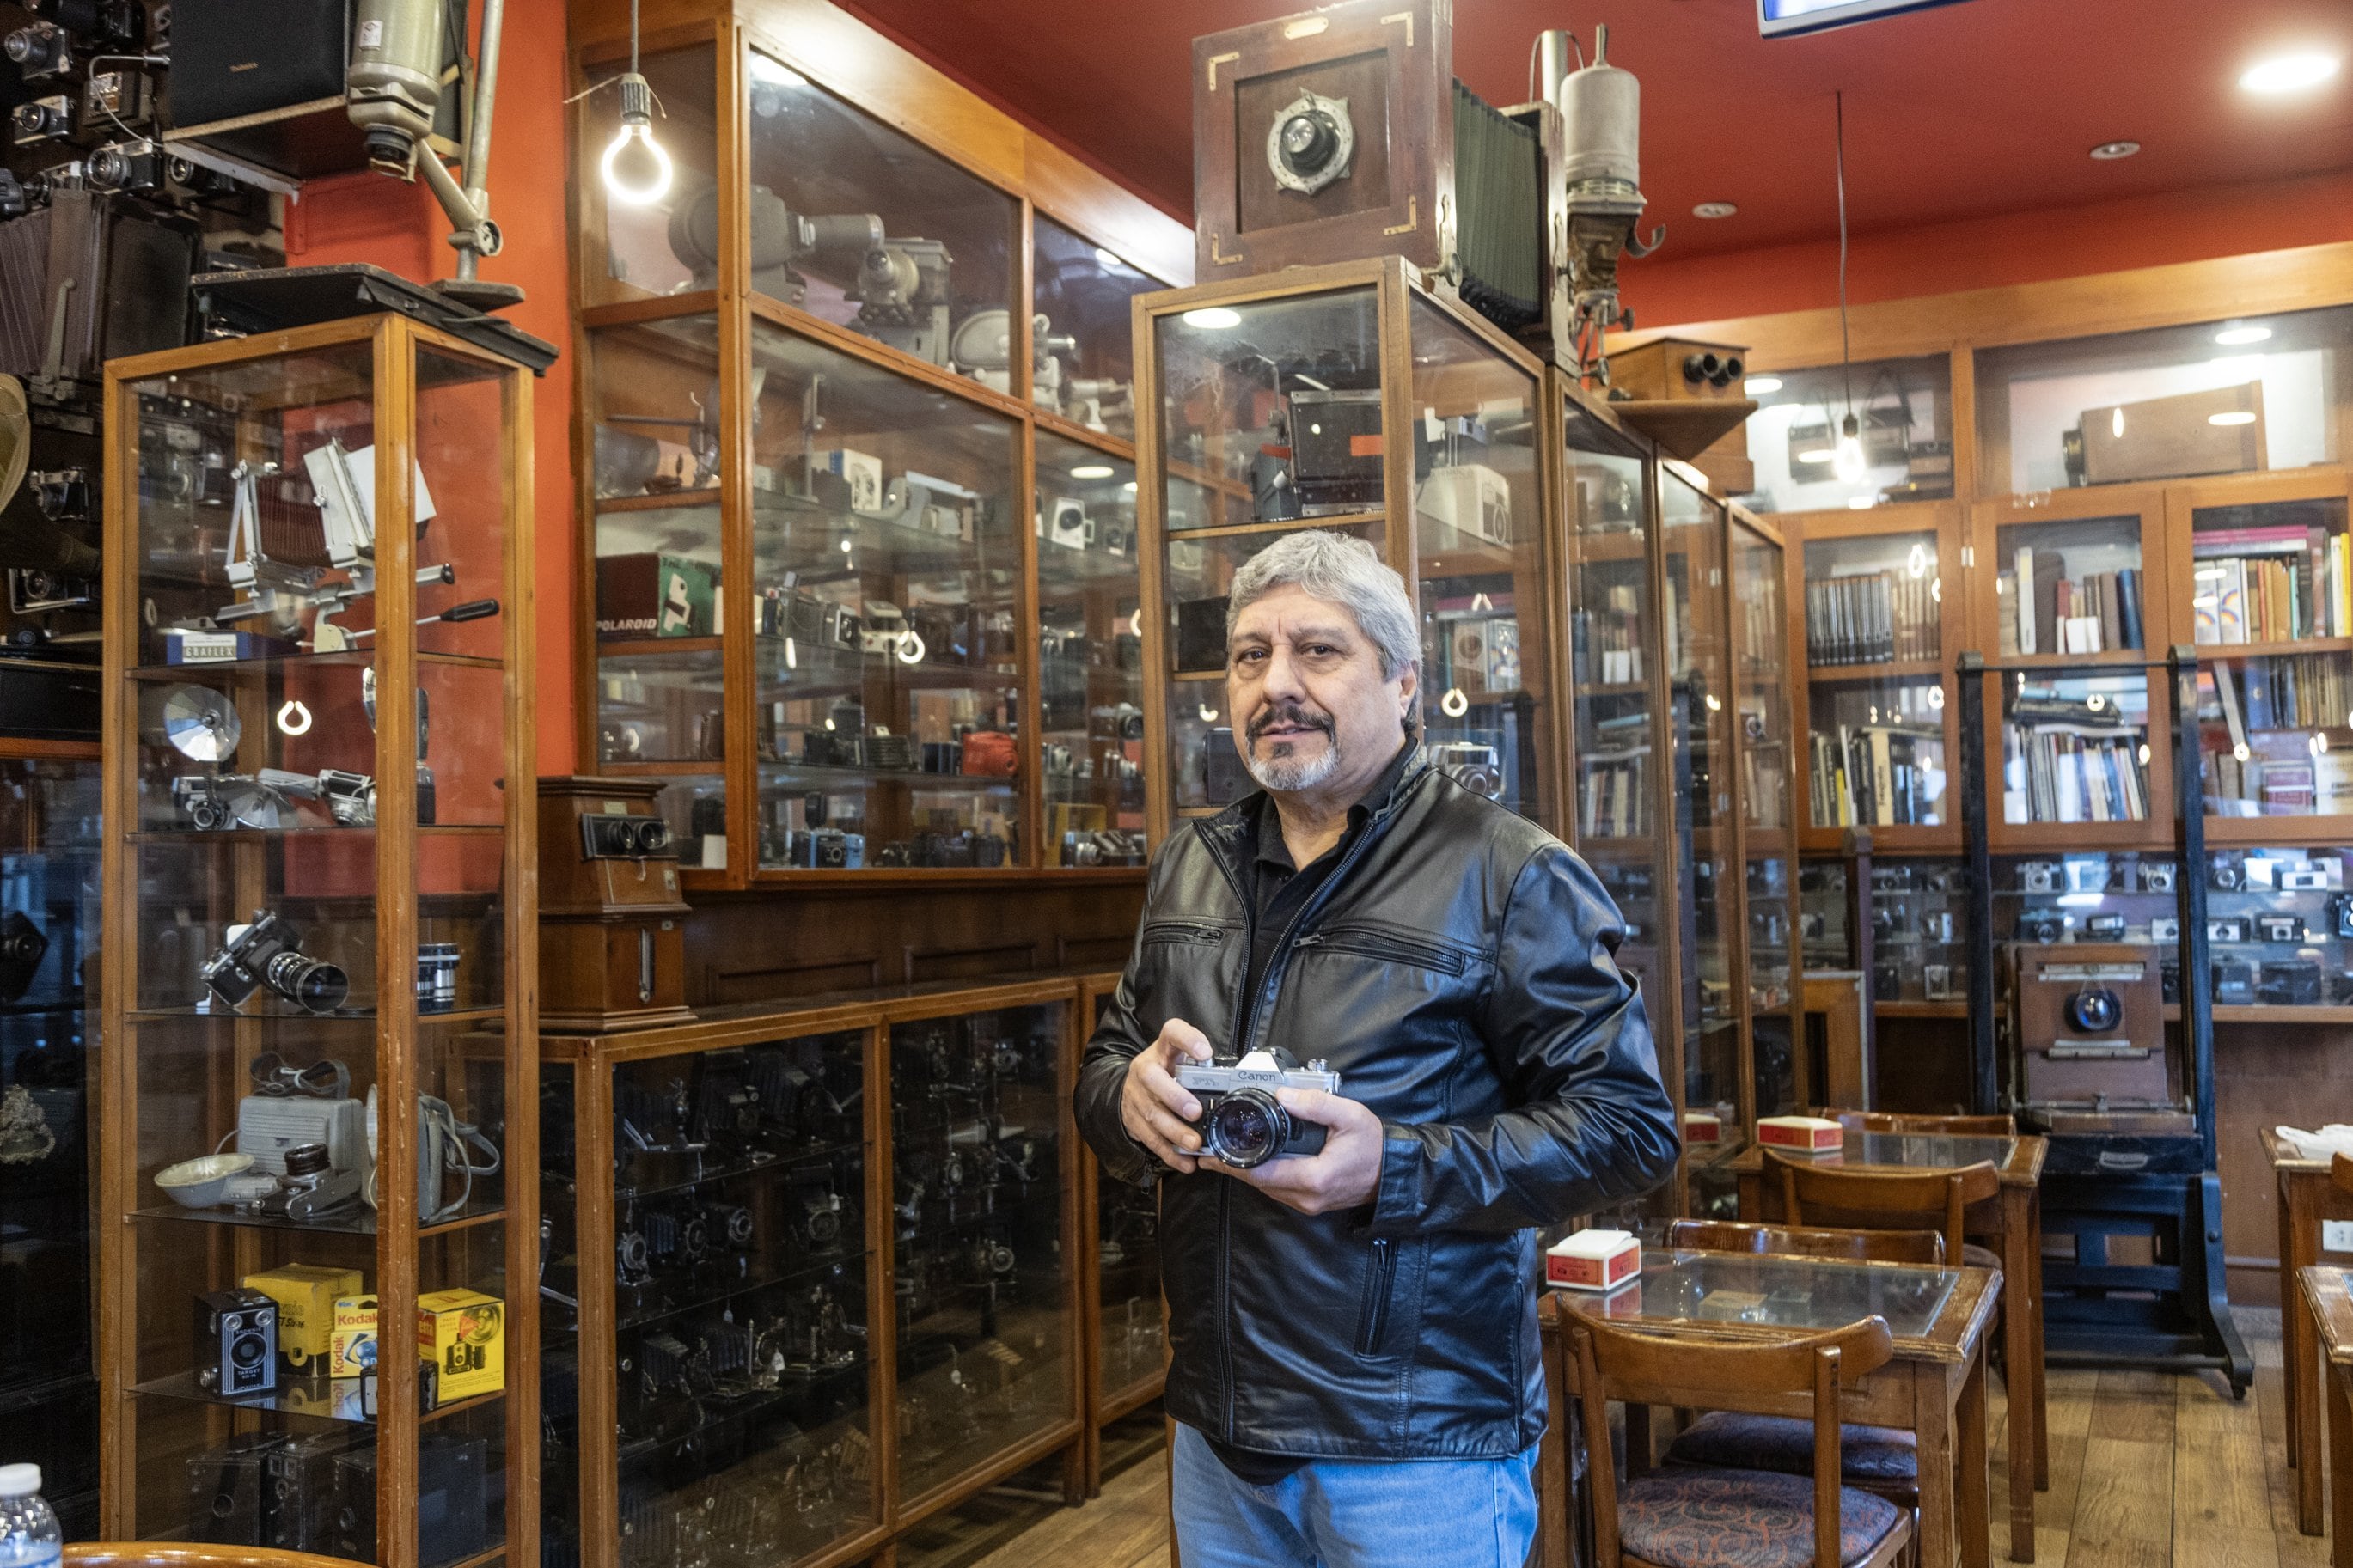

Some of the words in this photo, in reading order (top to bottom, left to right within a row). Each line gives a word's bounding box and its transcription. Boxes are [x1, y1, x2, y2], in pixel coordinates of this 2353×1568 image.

[596, 619, 657, 631] POLAROID
[186, 647, 233, 656] GRAFLEX
[1238, 1071, 1275, 1082] Canon
[333, 1336, 345, 1374] Kodak
